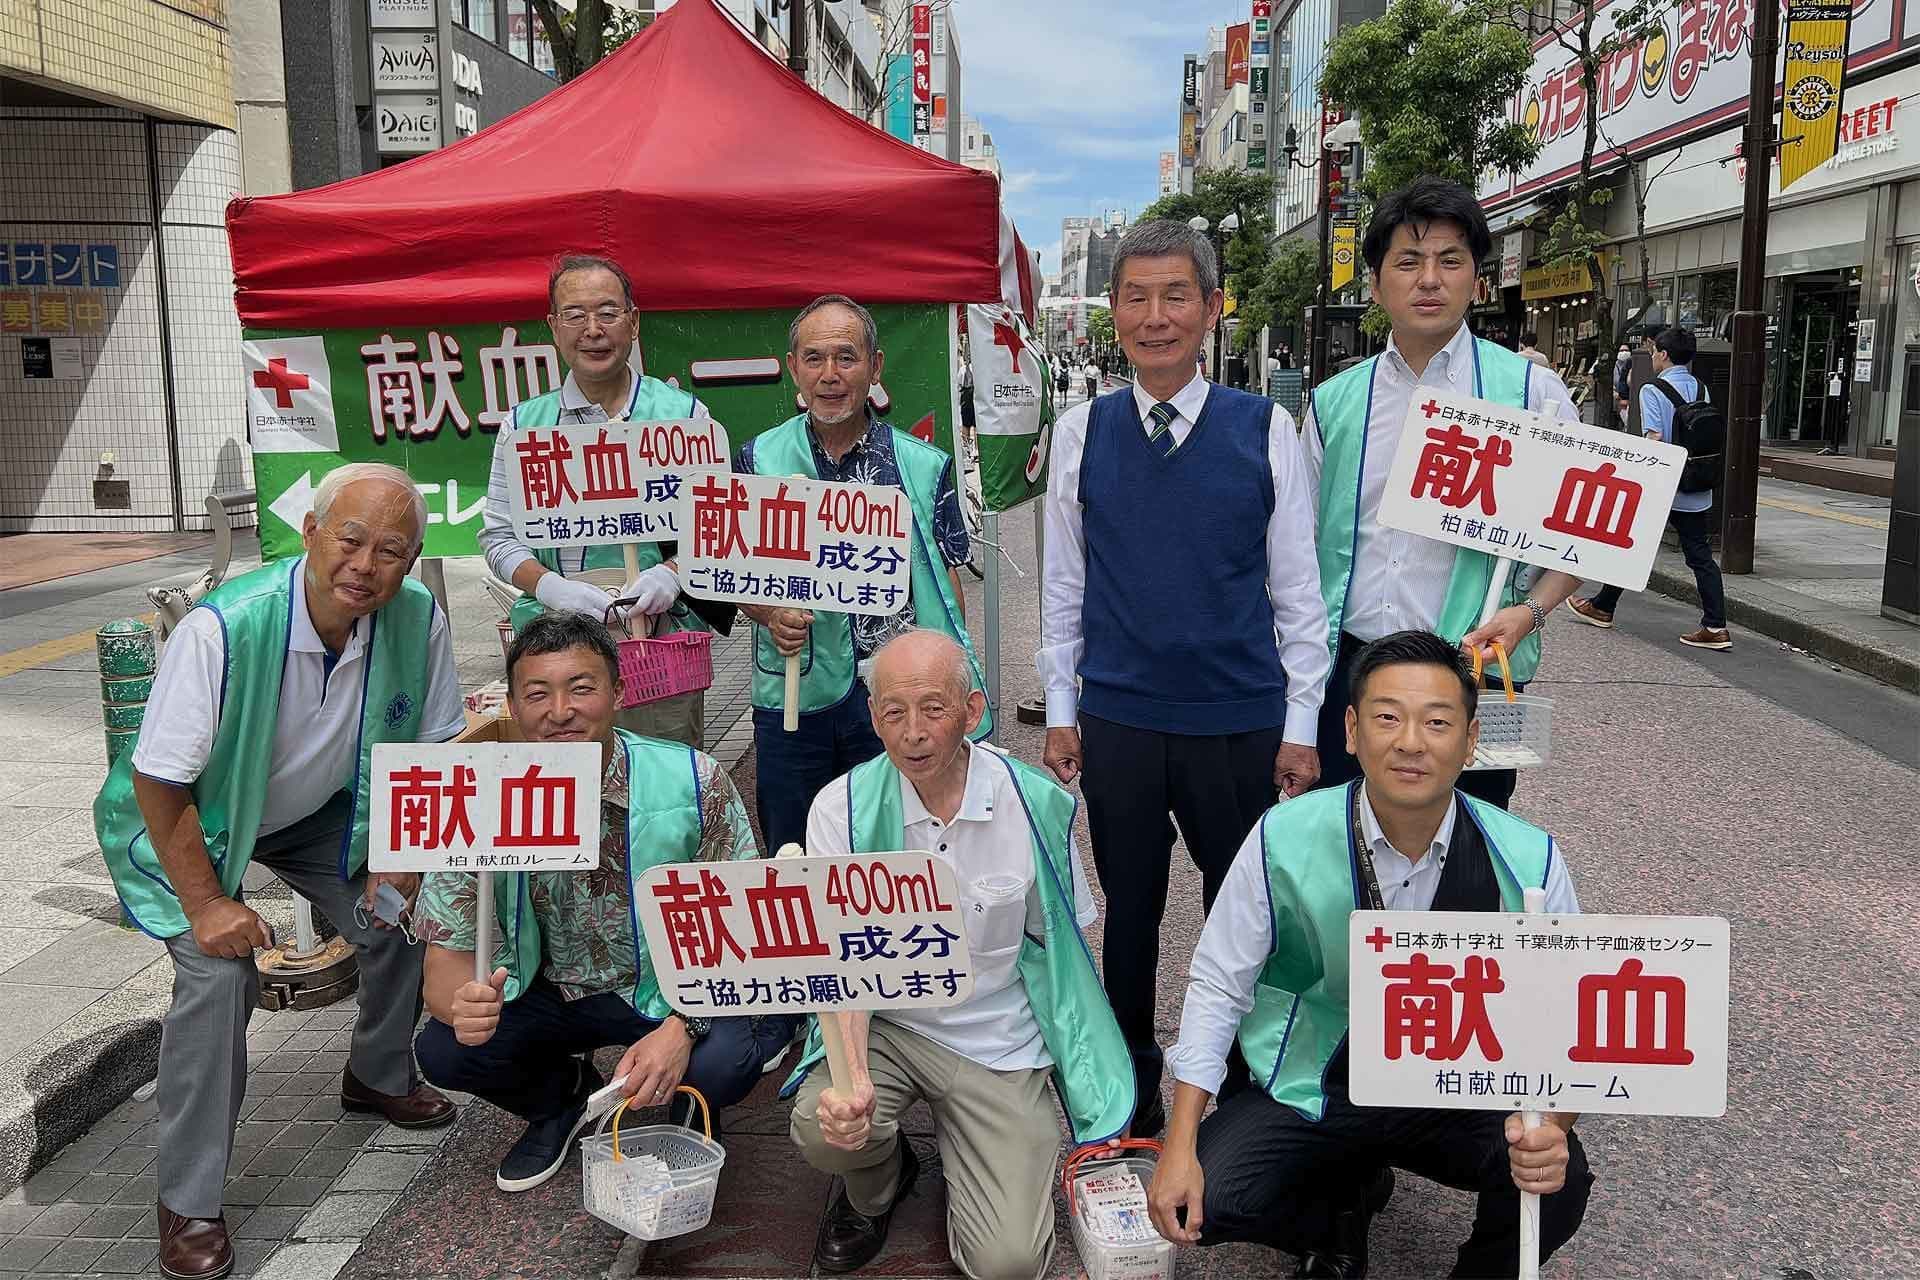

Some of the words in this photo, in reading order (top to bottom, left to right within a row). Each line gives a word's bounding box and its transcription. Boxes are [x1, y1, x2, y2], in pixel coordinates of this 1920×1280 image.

[1787, 42, 1845, 63] Reysol
[638, 424, 726, 468] 400mL
[1441, 406, 1521, 437] 日本赤十字社
[1529, 426, 1672, 468] 千葉県赤十字血液センター
[515, 430, 639, 511] 献血
[1410, 424, 1643, 550] 献血
[692, 475, 812, 563] 献血
[817, 488, 906, 539] 400mL
[1440, 511, 1580, 565] 柏献血ルーム
[816, 540, 906, 576] 成分
[688, 567, 905, 609] ご協力お願いします
[389, 764, 580, 851] 献血
[446, 853, 590, 867] 柏献血ルーム
[826, 859, 953, 917] 400mL
[652, 866, 831, 971] 献血
[839, 923, 961, 961] 成分
[1395, 931, 1505, 951] 日本赤十字社
[1515, 934, 1713, 952] 千葉県赤十字血液センター
[677, 968, 967, 1008] ご協力お願いします
[1381, 952, 1695, 1066] 献血
[1434, 1069, 1631, 1099] 柏献血ルーム
